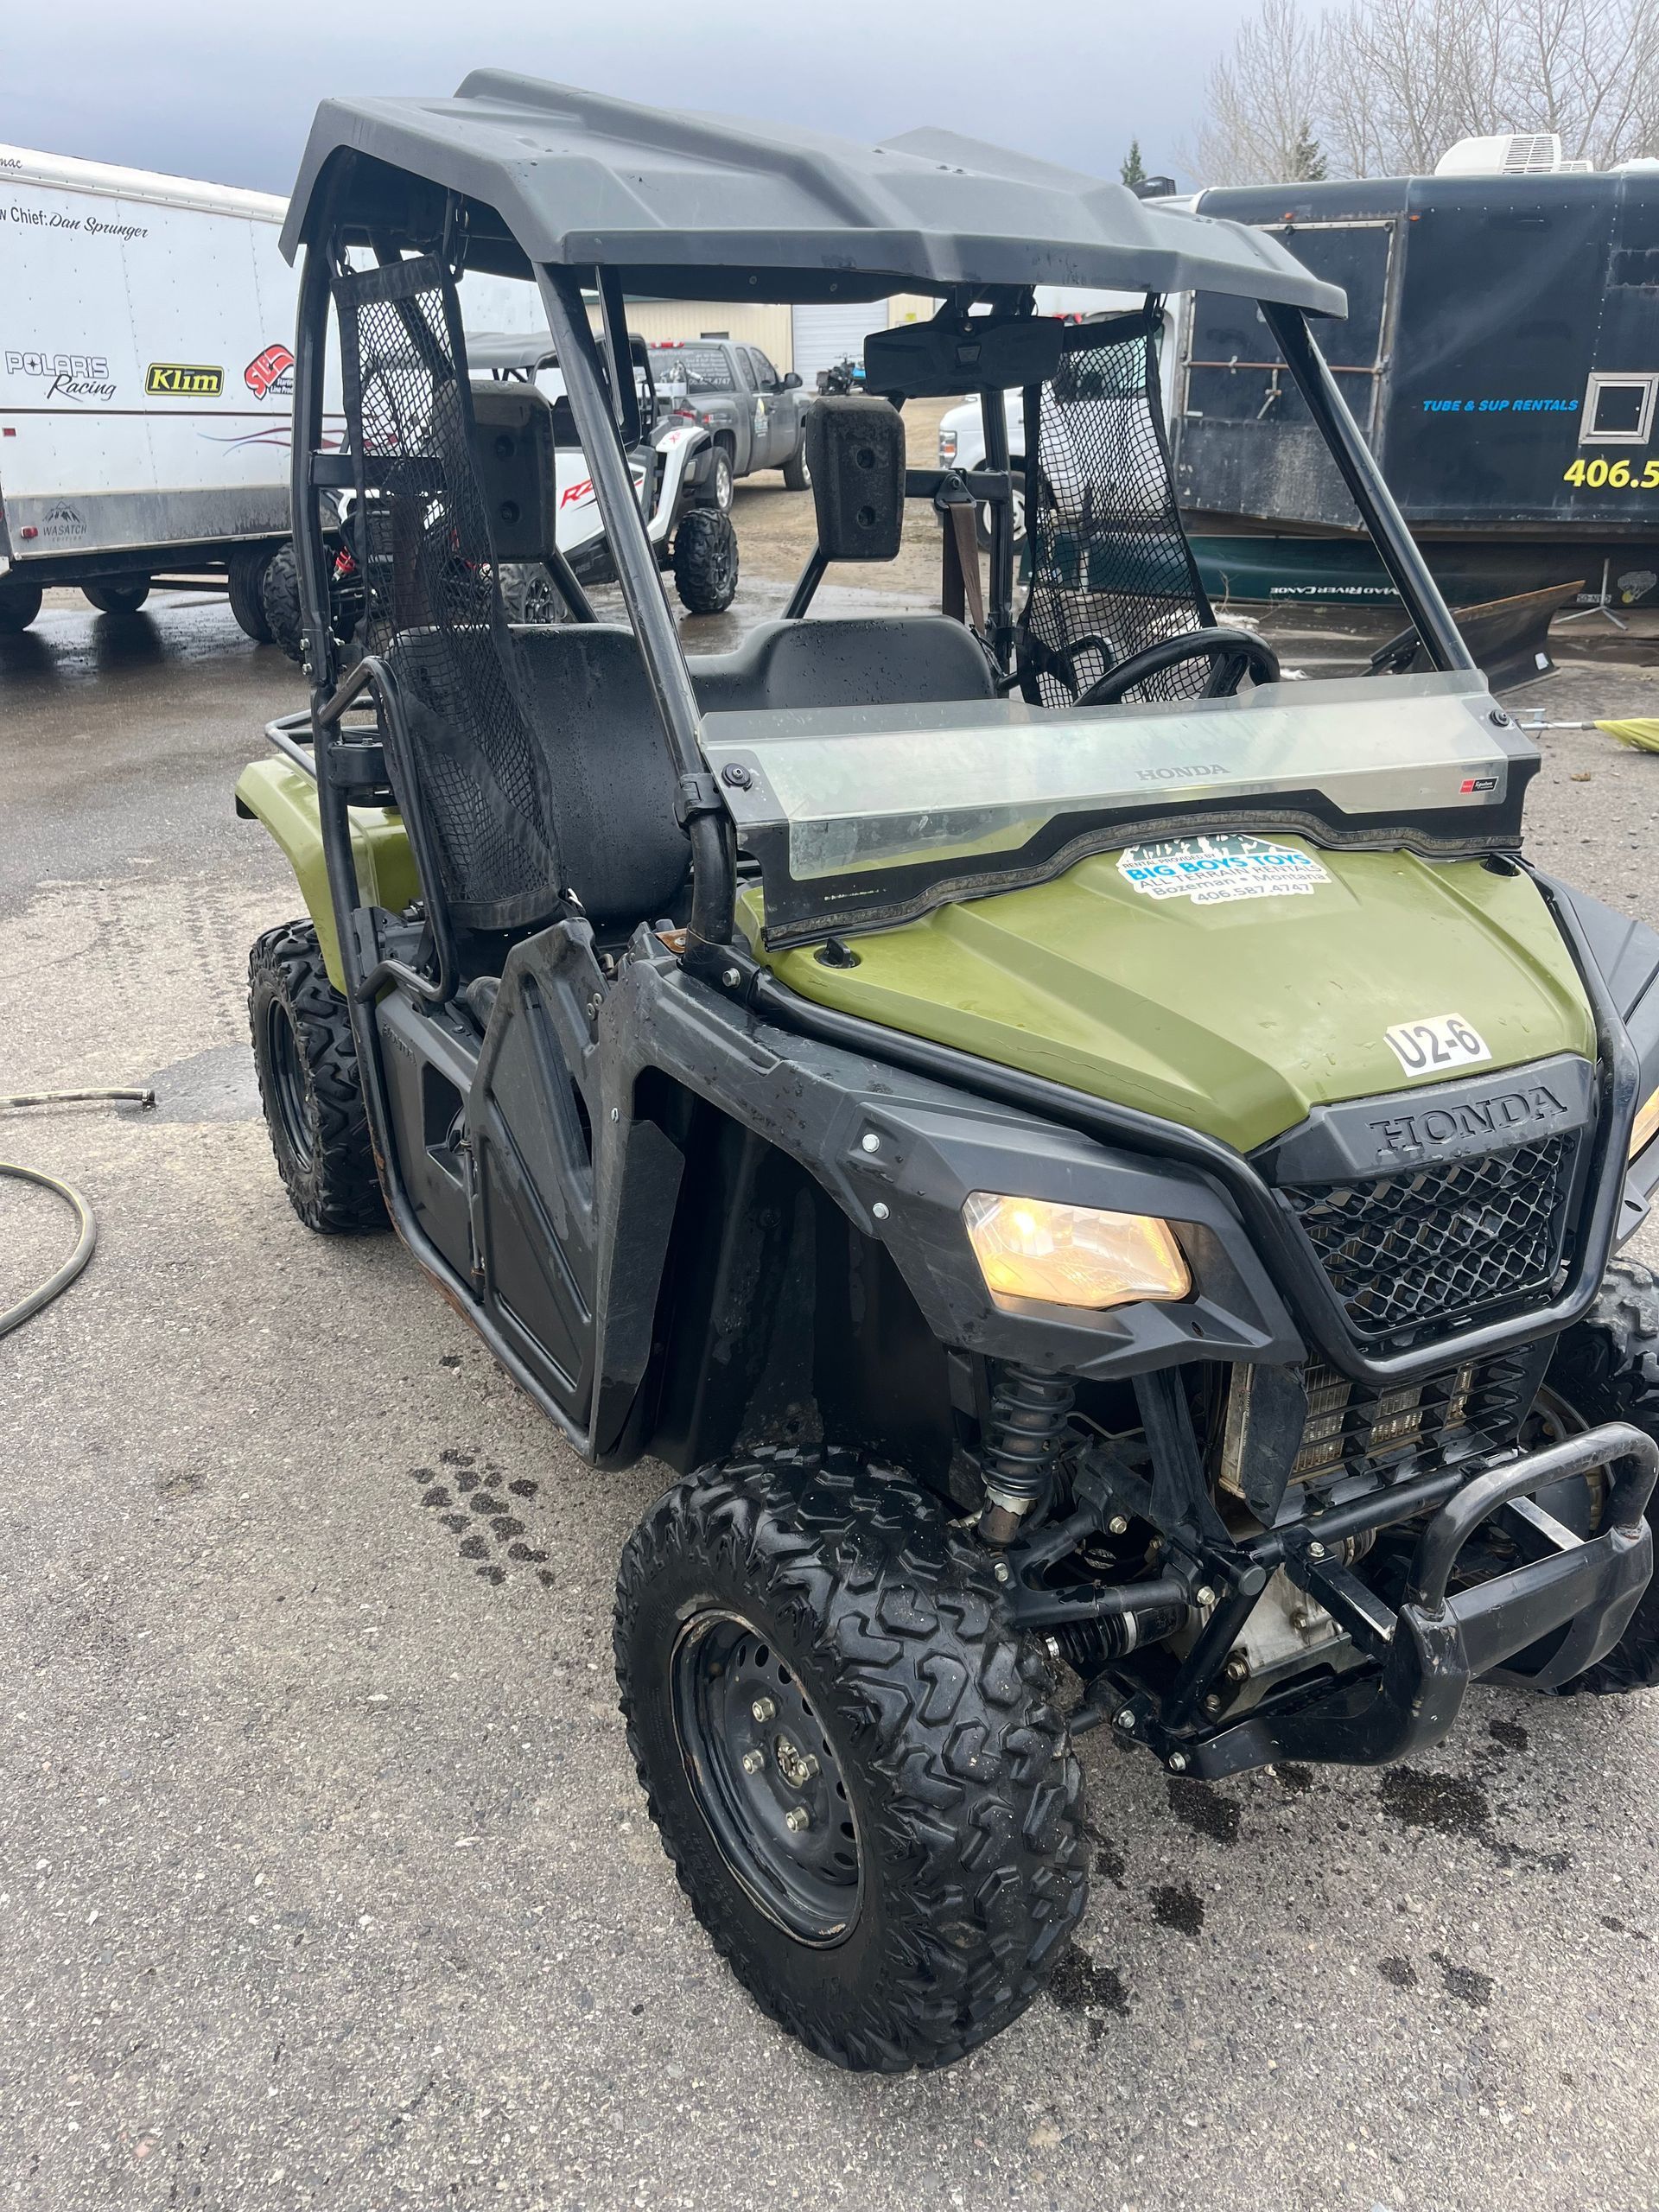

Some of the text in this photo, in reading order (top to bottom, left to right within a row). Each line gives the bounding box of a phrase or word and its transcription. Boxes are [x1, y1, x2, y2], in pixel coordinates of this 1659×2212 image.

[10, 207, 48, 226] Chief:
[49, 212, 82, 230] Dan
[84, 216, 149, 241] Sprunger
[5, 351, 110, 379] POLARIS
[46, 374, 118, 403] Racing
[150, 369, 219, 391] Klim
[1423, 400, 1579, 411] TUBE & SUP RENTALS
[1563, 459, 1659, 489] 406.5
[43, 524, 87, 536] WASATCH
[1134, 764, 1231, 781] HONDA
[1123, 860, 1156, 868] RENTAL
[1158, 855, 1204, 863] PROVIDED
[1126, 855, 1312, 880] BIG BOYS TOYS
[1141, 865, 1322, 889] ALL TERRAIN RENTALS
[1152, 873, 1327, 896] Bozeman Montana
[1198, 883, 1310, 901] 406.587.4747
[1385, 1020, 1480, 1069] U2-6
[1370, 1086, 1568, 1151] HONDA
